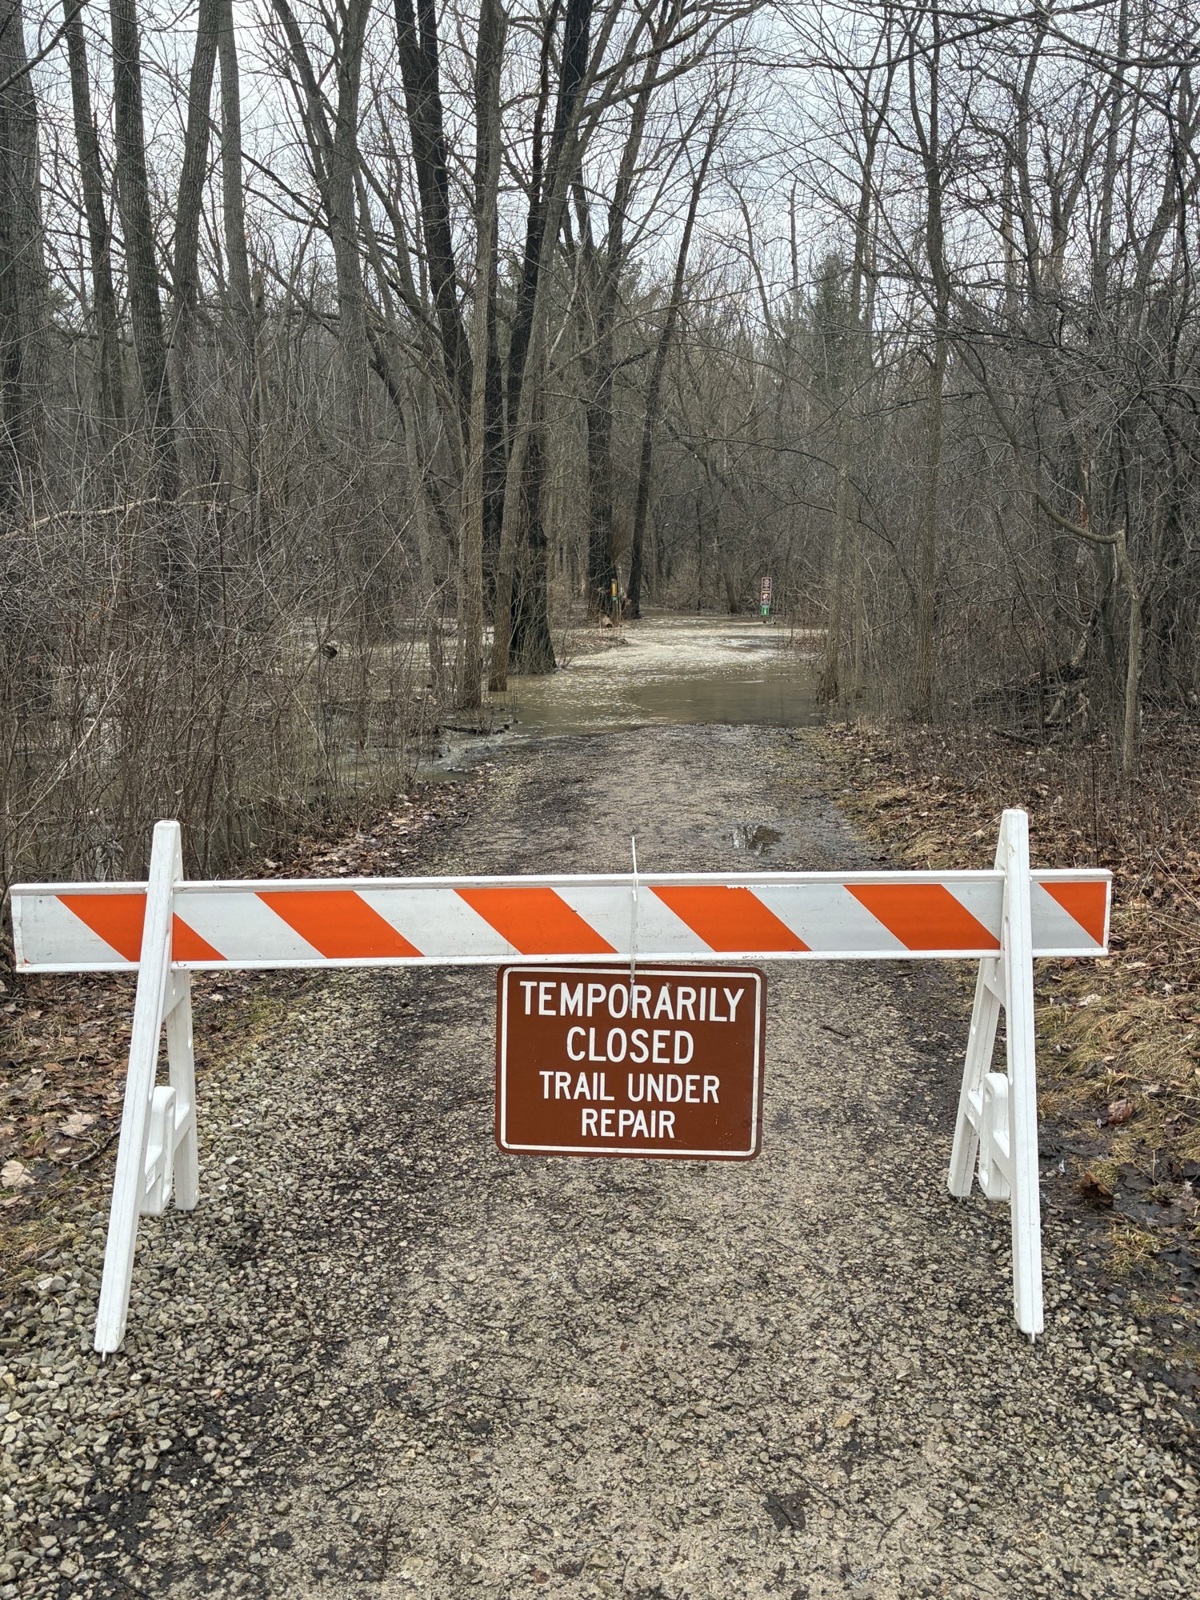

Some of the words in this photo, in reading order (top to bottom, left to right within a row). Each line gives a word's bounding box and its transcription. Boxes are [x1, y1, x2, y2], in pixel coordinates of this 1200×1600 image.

[520, 981, 745, 1022] TEMPORARILY
[566, 1026, 694, 1065] CLOSED
[539, 1071, 615, 1101] TRAIL
[628, 1073, 720, 1104] UNDER
[581, 1108, 676, 1139] REPAIR
